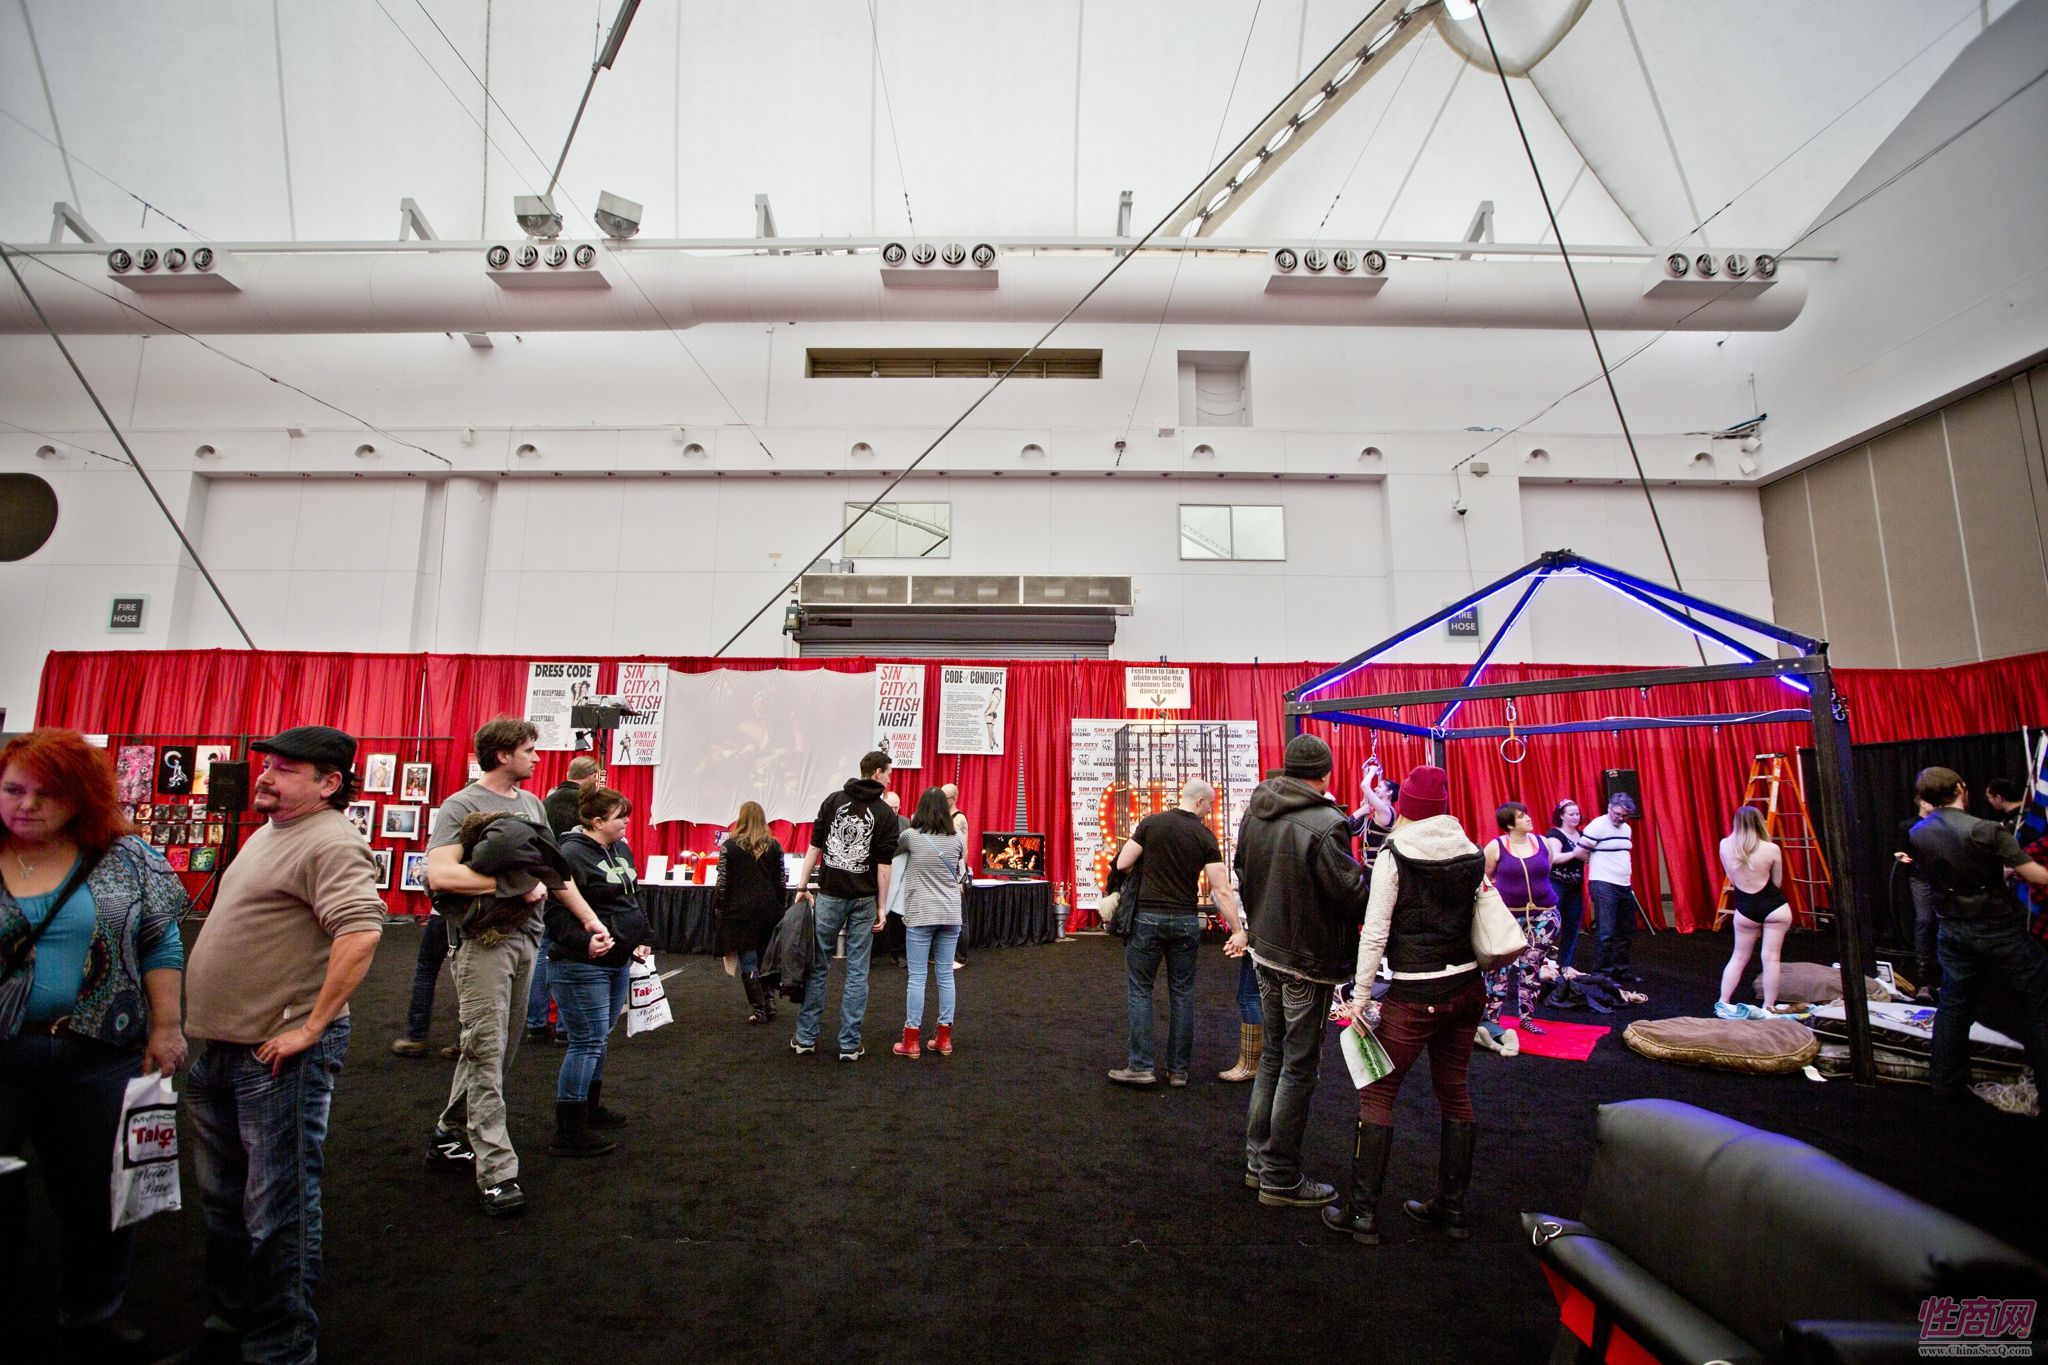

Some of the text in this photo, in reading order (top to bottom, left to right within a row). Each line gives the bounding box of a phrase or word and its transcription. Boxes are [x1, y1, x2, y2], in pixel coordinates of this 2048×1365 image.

[118, 603, 137, 611] FIRE
[113, 614, 138, 623] HOSE
[1451, 622, 1476, 631] HOSE
[535, 665, 592, 678] DRESS CODE
[624, 665, 646, 678] SIN
[880, 666, 901, 680] SIN
[944, 670, 963, 684] CODE
[970, 671, 1003, 685] CONDUCT
[623, 680, 648, 694] CITY
[880, 682, 907, 696] CITY
[879, 697, 920, 712] FETISH
[878, 712, 917, 727] NIGHT
[633, 731, 657, 739] KINKY &
[892, 733, 917, 741] KINKY &
[634, 739, 656, 747] PROUD
[893, 741, 915, 750] PROUD
[635, 748, 655, 756] SINCE
[895, 751, 914, 759] SINCE
[896, 759, 913, 767] 2001
